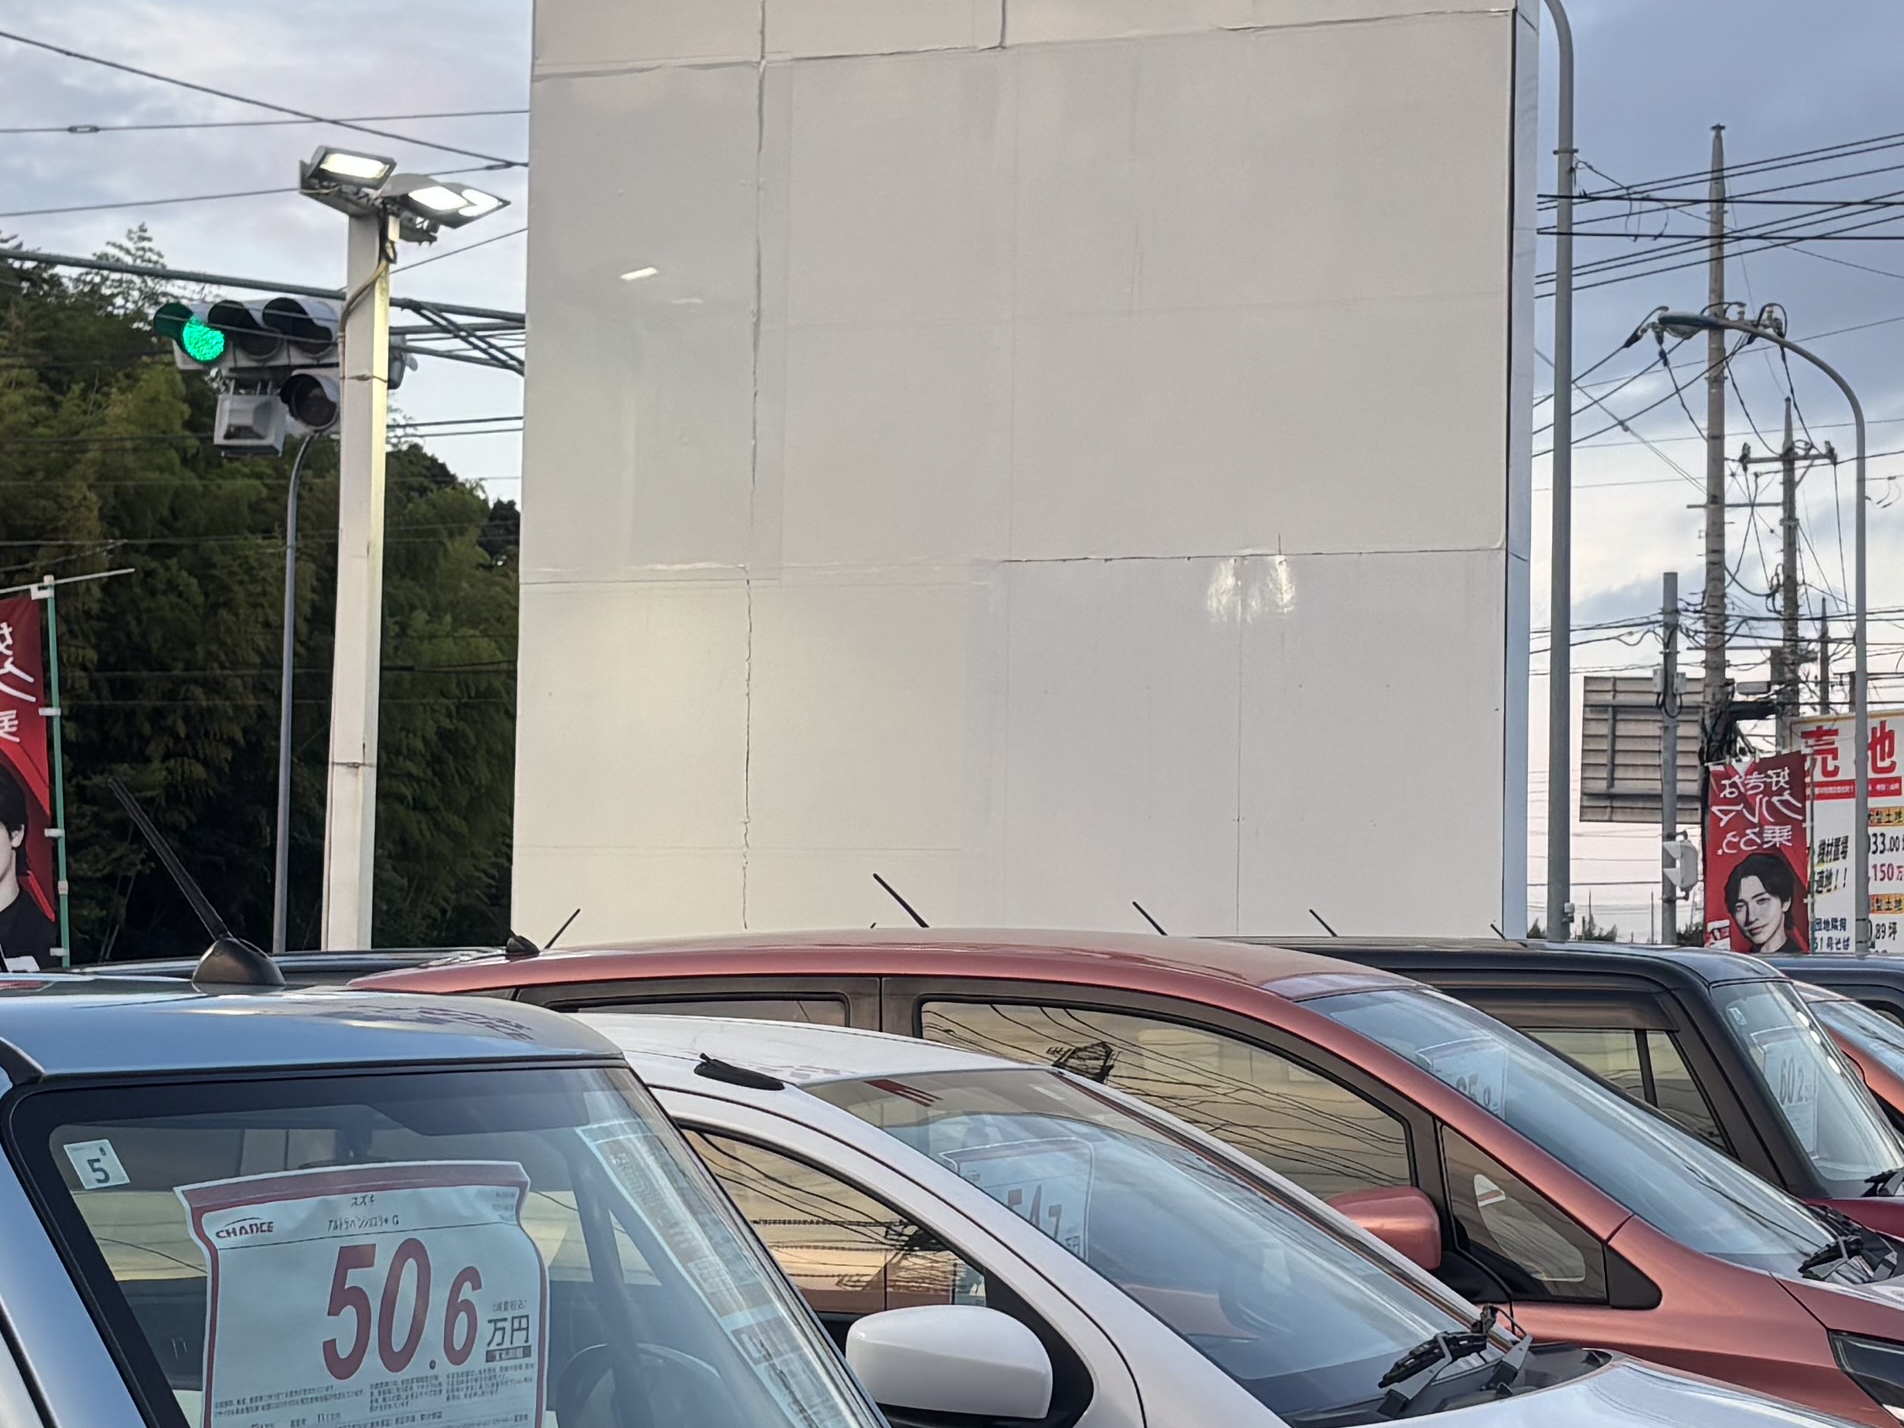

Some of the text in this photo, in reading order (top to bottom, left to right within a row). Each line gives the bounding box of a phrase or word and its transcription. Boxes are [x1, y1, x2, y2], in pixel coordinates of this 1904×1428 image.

[87, 1158, 110, 1184] 5
[215, 1220, 275, 1240] CHANCE
[486, 1314, 530, 1348] 万円
